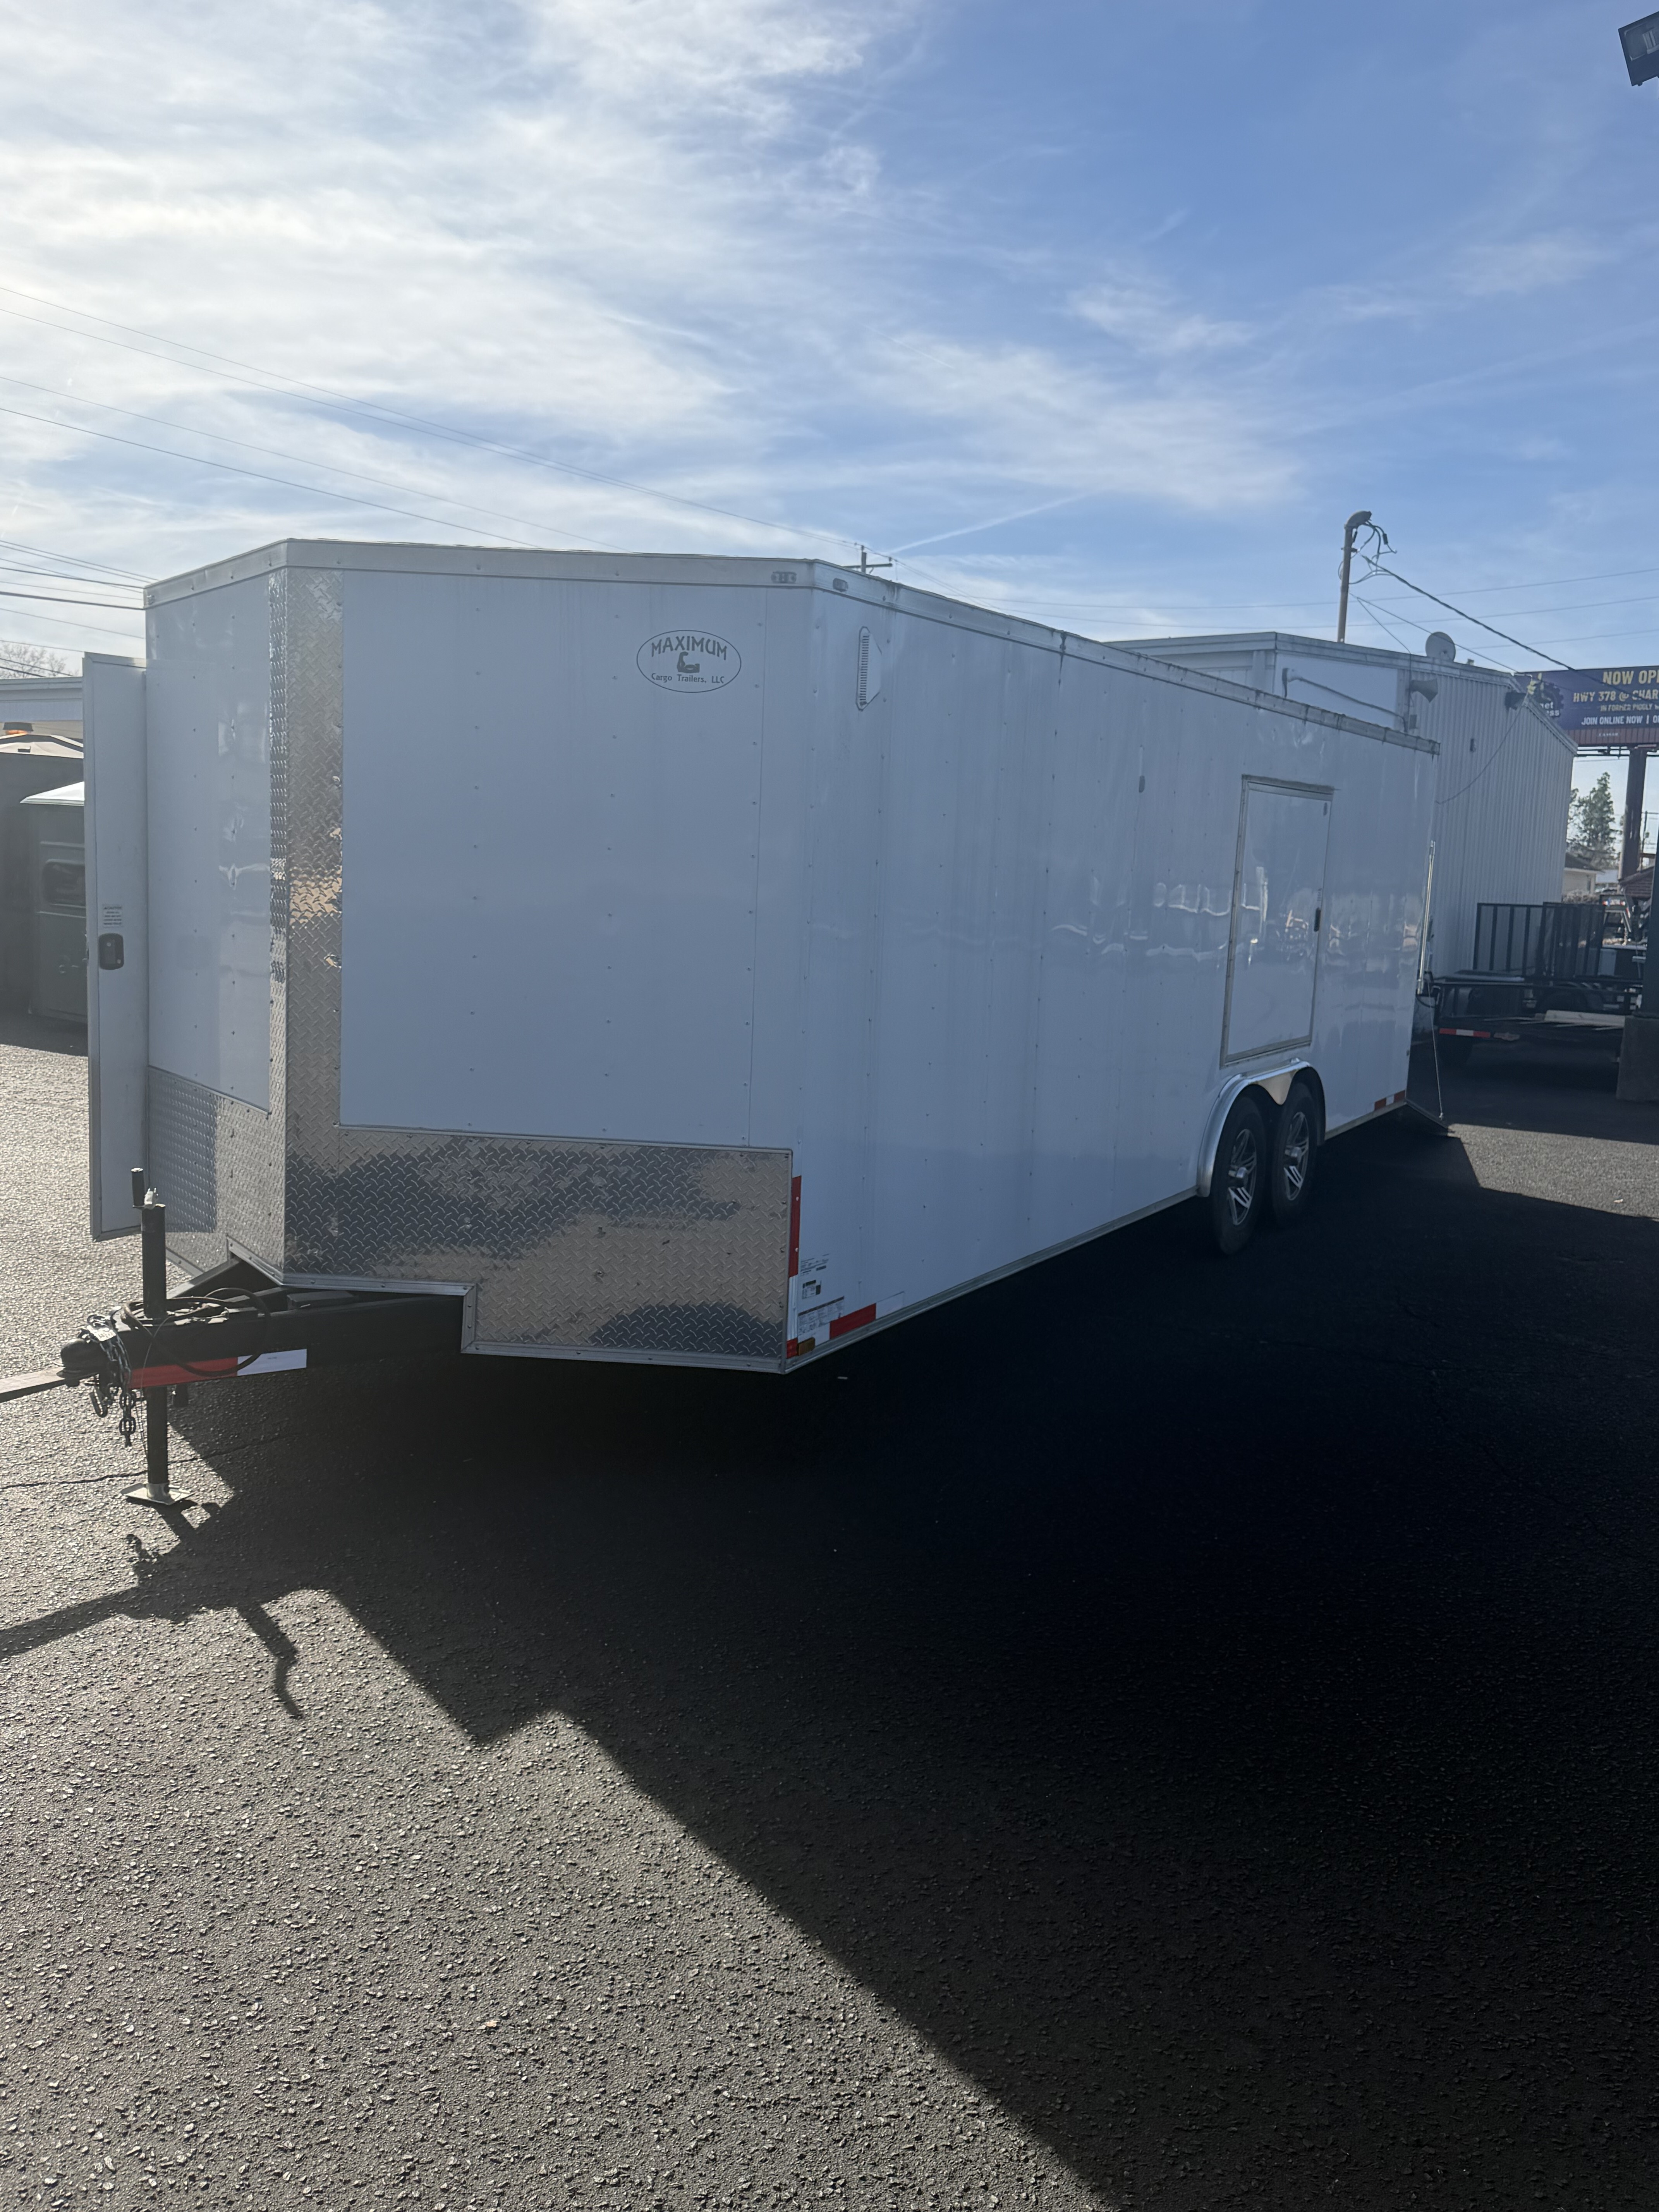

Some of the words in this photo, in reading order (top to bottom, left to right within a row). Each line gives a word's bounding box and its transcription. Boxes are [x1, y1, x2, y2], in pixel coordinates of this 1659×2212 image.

[651, 635, 727, 661] MAXIMUM
[651, 673, 672, 683] Cargo
[677, 674, 707, 684] Trailers,
[1603, 671, 1634, 685] NOW
[1573, 692, 1595, 702] HWY
[1598, 691, 1616, 701] 378
[1619, 692, 1629, 702] @
[1581, 717, 1598, 725] JOIN
[1599, 716, 1625, 725] ONLINE
[1626, 715, 1643, 724] NOW
